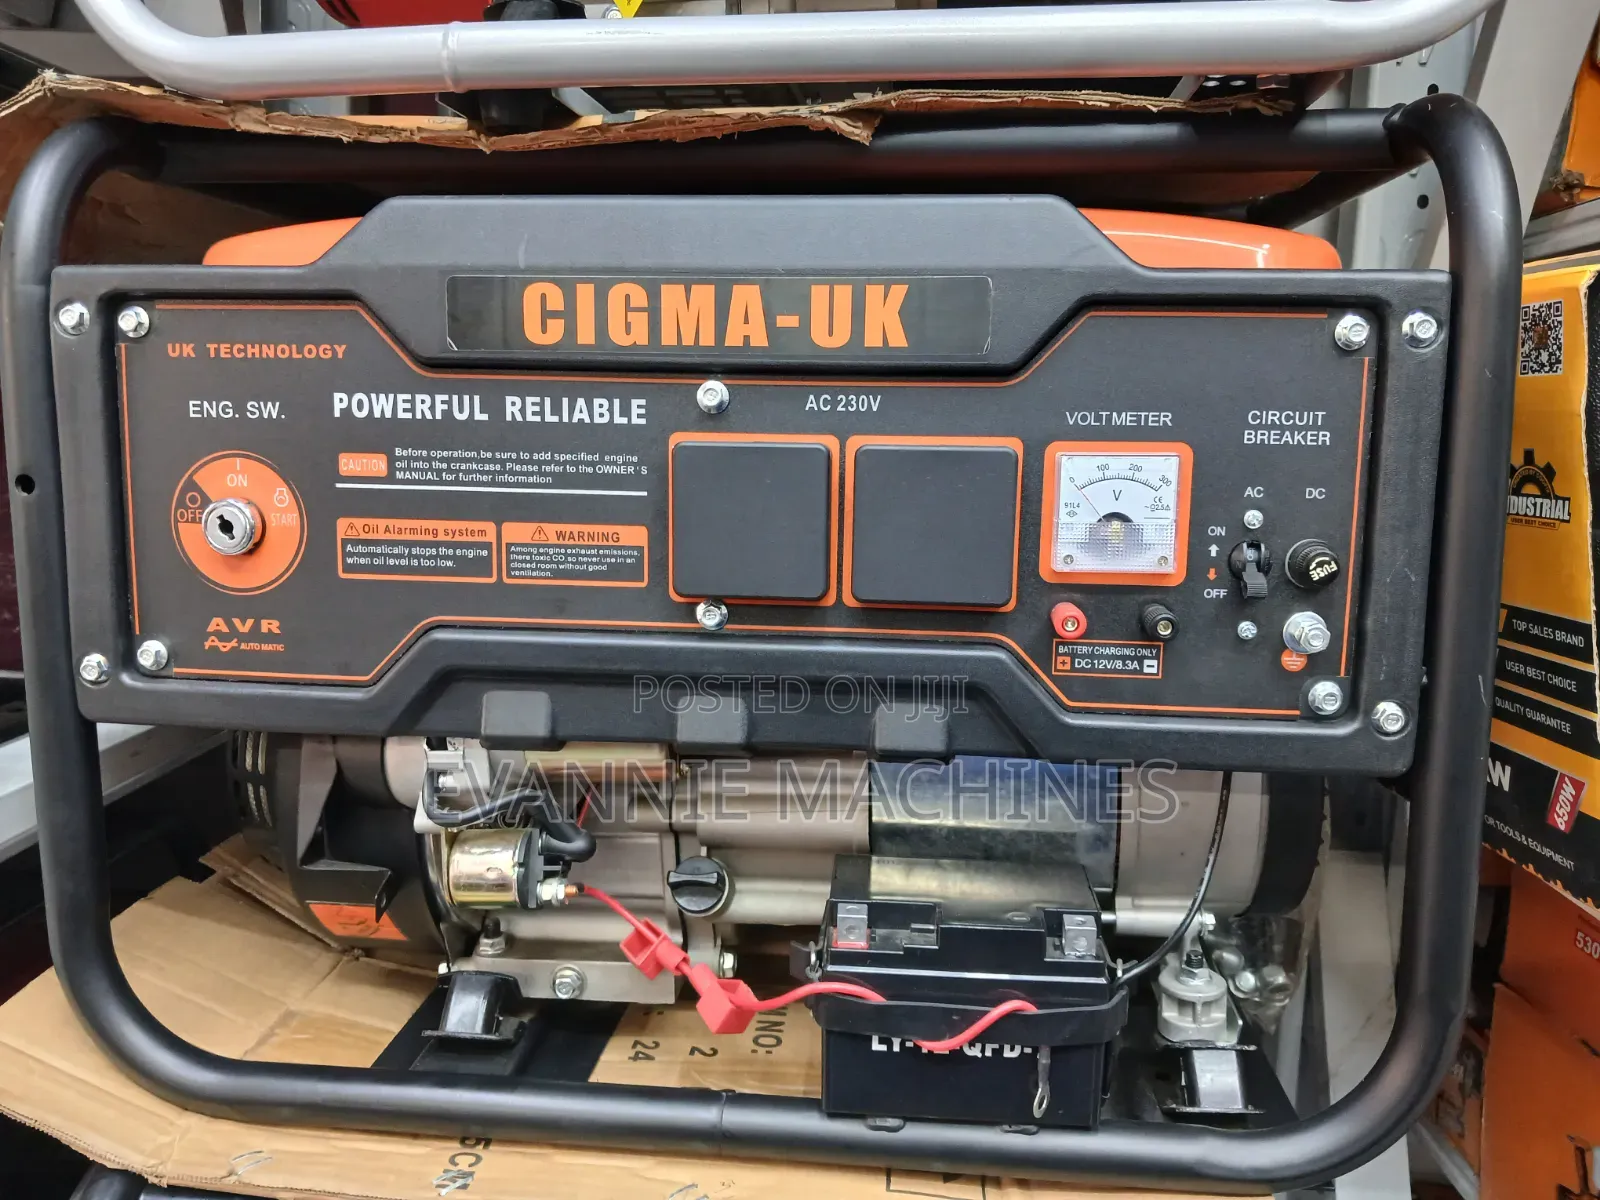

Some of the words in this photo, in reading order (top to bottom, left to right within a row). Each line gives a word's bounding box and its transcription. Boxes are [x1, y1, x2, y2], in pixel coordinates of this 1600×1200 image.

[522, 282, 909, 348] CIGMA-UK
[167, 343, 196, 359] UK
[207, 343, 348, 360] TECHNOLOGY
[189, 400, 240, 419] ENG.
[246, 401, 286, 420] SW.
[333, 392, 489, 421] POWERFUL
[505, 395, 647, 425] RELIABLE
[805, 394, 831, 411] AC
[837, 395, 881, 412] 230V
[1247, 410, 1326, 426] CIRCUIT
[1243, 430, 1331, 446] BREAKER
[395, 447, 427, 459] Before
[495, 451, 518, 460] sure
[519, 450, 530, 460] to
[532, 450, 552, 461] add
[554, 451, 600, 463] specified
[604, 453, 638, 465] engine
[341, 458, 387, 473] CAUTION
[395, 460, 408, 470] oil
[410, 460, 430, 470] into
[432, 460, 448, 470] the
[450, 461, 504, 471] crankcase.
[506, 462, 539, 473] Please
[541, 463, 562, 473] refer
[564, 464, 576, 474] to
[578, 464, 594, 474] the
[1096, 463, 1110, 472] 100
[1128, 463, 1143, 472] 200
[226, 473, 248, 487] ON
[396, 470, 440, 480] MANUAL
[442, 471, 455, 481] for
[458, 471, 493, 482] further
[495, 474, 552, 484] information
[1068, 476, 1076, 484] 0
[1158, 474, 1172, 487] 300
[1112, 489, 1122, 501] V
[1243, 487, 1264, 498] AC
[1305, 488, 1326, 499] DC
[177, 508, 203, 523] OFF
[271, 513, 297, 526] START
[362, 523, 379, 535] Oil
[384, 525, 439, 538] Alarming
[443, 526, 487, 539] system
[555, 530, 620, 543] WARNING
[1208, 526, 1226, 536] ON
[346, 544, 409, 556] Automatically
[411, 546, 437, 557] stops
[439, 546, 454, 556] the
[456, 548, 488, 558] engine
[510, 545, 537, 555] Among
[539, 547, 565, 556] engine
[567, 547, 597, 556] exhaust
[510, 553, 531, 562] there
[532, 554, 551, 562] toxic
[346, 556, 371, 565] when
[373, 556, 384, 565] oil
[386, 556, 409, 566] level
[411, 557, 418, 566] is
[420, 557, 435, 567] too
[437, 558, 456, 567] low.
[510, 562, 536, 570] closed
[559, 563, 587, 571] without
[588, 563, 608, 572] good
[1308, 560, 1338, 581] FUSE
[1204, 588, 1228, 599] OFF
[206, 617, 281, 633] AVR
[1512, 619, 1527, 632] TOP
[1528, 623, 1554, 639] SALES
[1555, 630, 1584, 648] BRAND
[1058, 645, 1093, 655] BATTERY
[1094, 646, 1135, 656] CHARGING
[1136, 648, 1158, 657] ONLY
[1074, 658, 1092, 668] DC
[1093, 659, 1140, 670] 12V/8.3A
[1505, 660, 1525, 675] USER
[1527, 665, 1546, 681] BEST
[1548, 674, 1577, 693] CHOICE
[1495, 697, 1524, 716] QUALITY
[1526, 708, 1572, 735] GUARANTEE
[1486, 757, 1511, 792] W
[1554, 777, 1576, 831] 650W
[1496, 820, 1521, 842] TOOLS
[1521, 834, 1528, 845] &
[1528, 838, 1575, 871] EQUIPMENT
[628, 1039, 660, 1063] 24
[689, 1046, 719, 1058] 2
